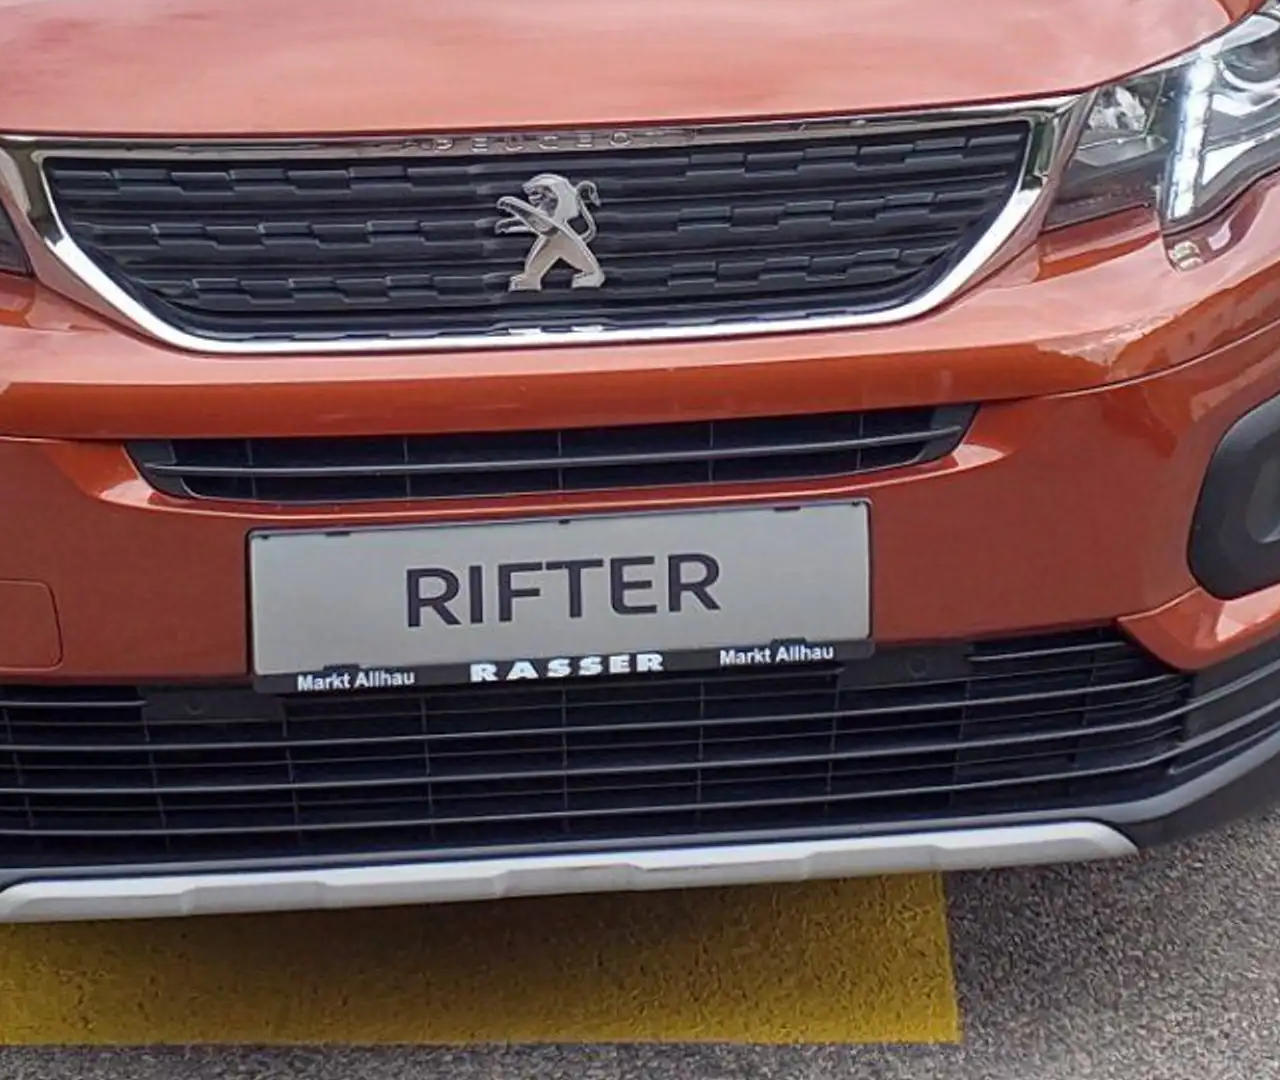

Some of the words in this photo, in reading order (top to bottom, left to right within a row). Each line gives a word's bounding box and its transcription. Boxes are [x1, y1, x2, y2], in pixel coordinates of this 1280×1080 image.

[404, 552, 722, 628] RIFTER
[470, 652, 665, 682] RASSER
[720, 646, 772, 666] Markt
[775, 642, 834, 663] Allhau
[297, 672, 352, 692] Markt
[353, 668, 415, 689] Allhau
